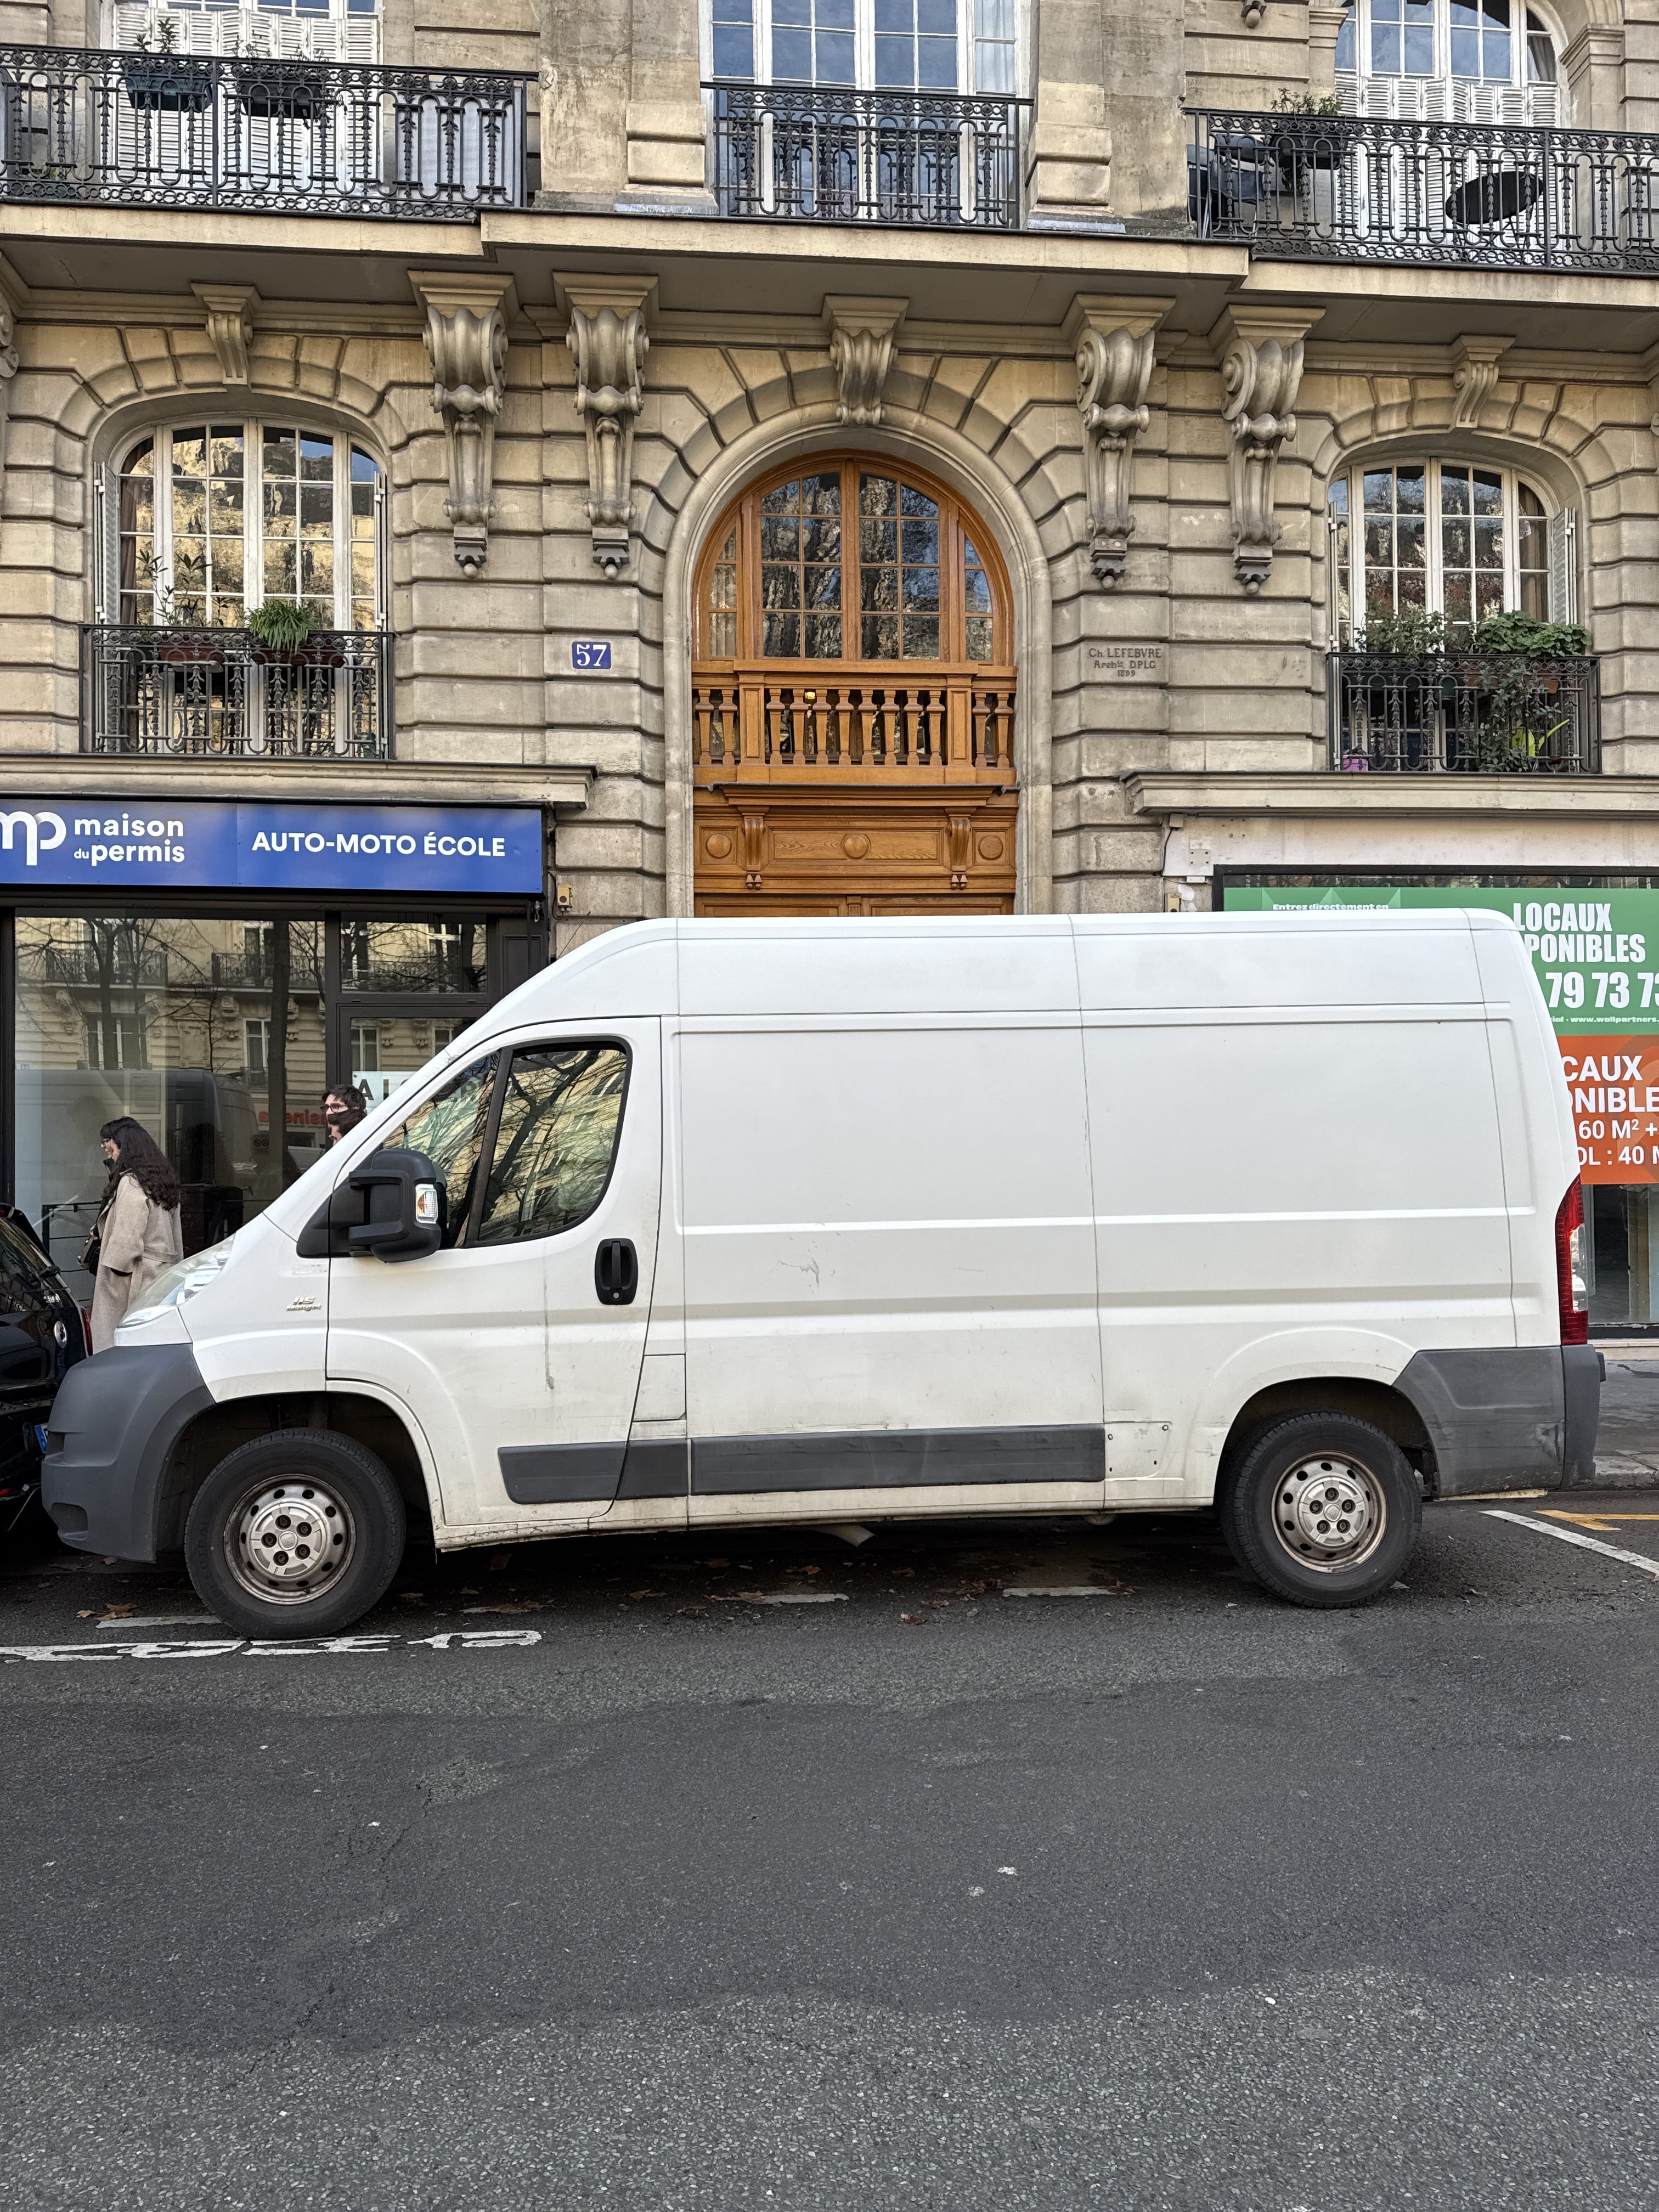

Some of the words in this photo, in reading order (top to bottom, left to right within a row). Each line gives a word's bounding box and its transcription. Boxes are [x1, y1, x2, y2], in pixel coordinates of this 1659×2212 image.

[577, 644, 607, 666] 57
[1107, 648, 1162, 658] LEFEBVRE
[74, 812, 184, 837] maison
[74, 848, 89, 860] du
[91, 839, 185, 866] permis
[251, 832, 416, 855] AUTO-MOTO
[424, 831, 505, 856] ÉCOLE
[1513, 902, 1612, 932] LOCAUX
[1524, 933, 1646, 963] PONIBLES
[1545, 972, 1584, 1008] 79
[1592, 972, 1630, 1008] 73
[1637, 972, 1659, 1008] 7
[1561, 1056, 1644, 1082] CAUX
[1578, 1120, 1605, 1139] 60
[1618, 1146, 1644, 1165] 40
